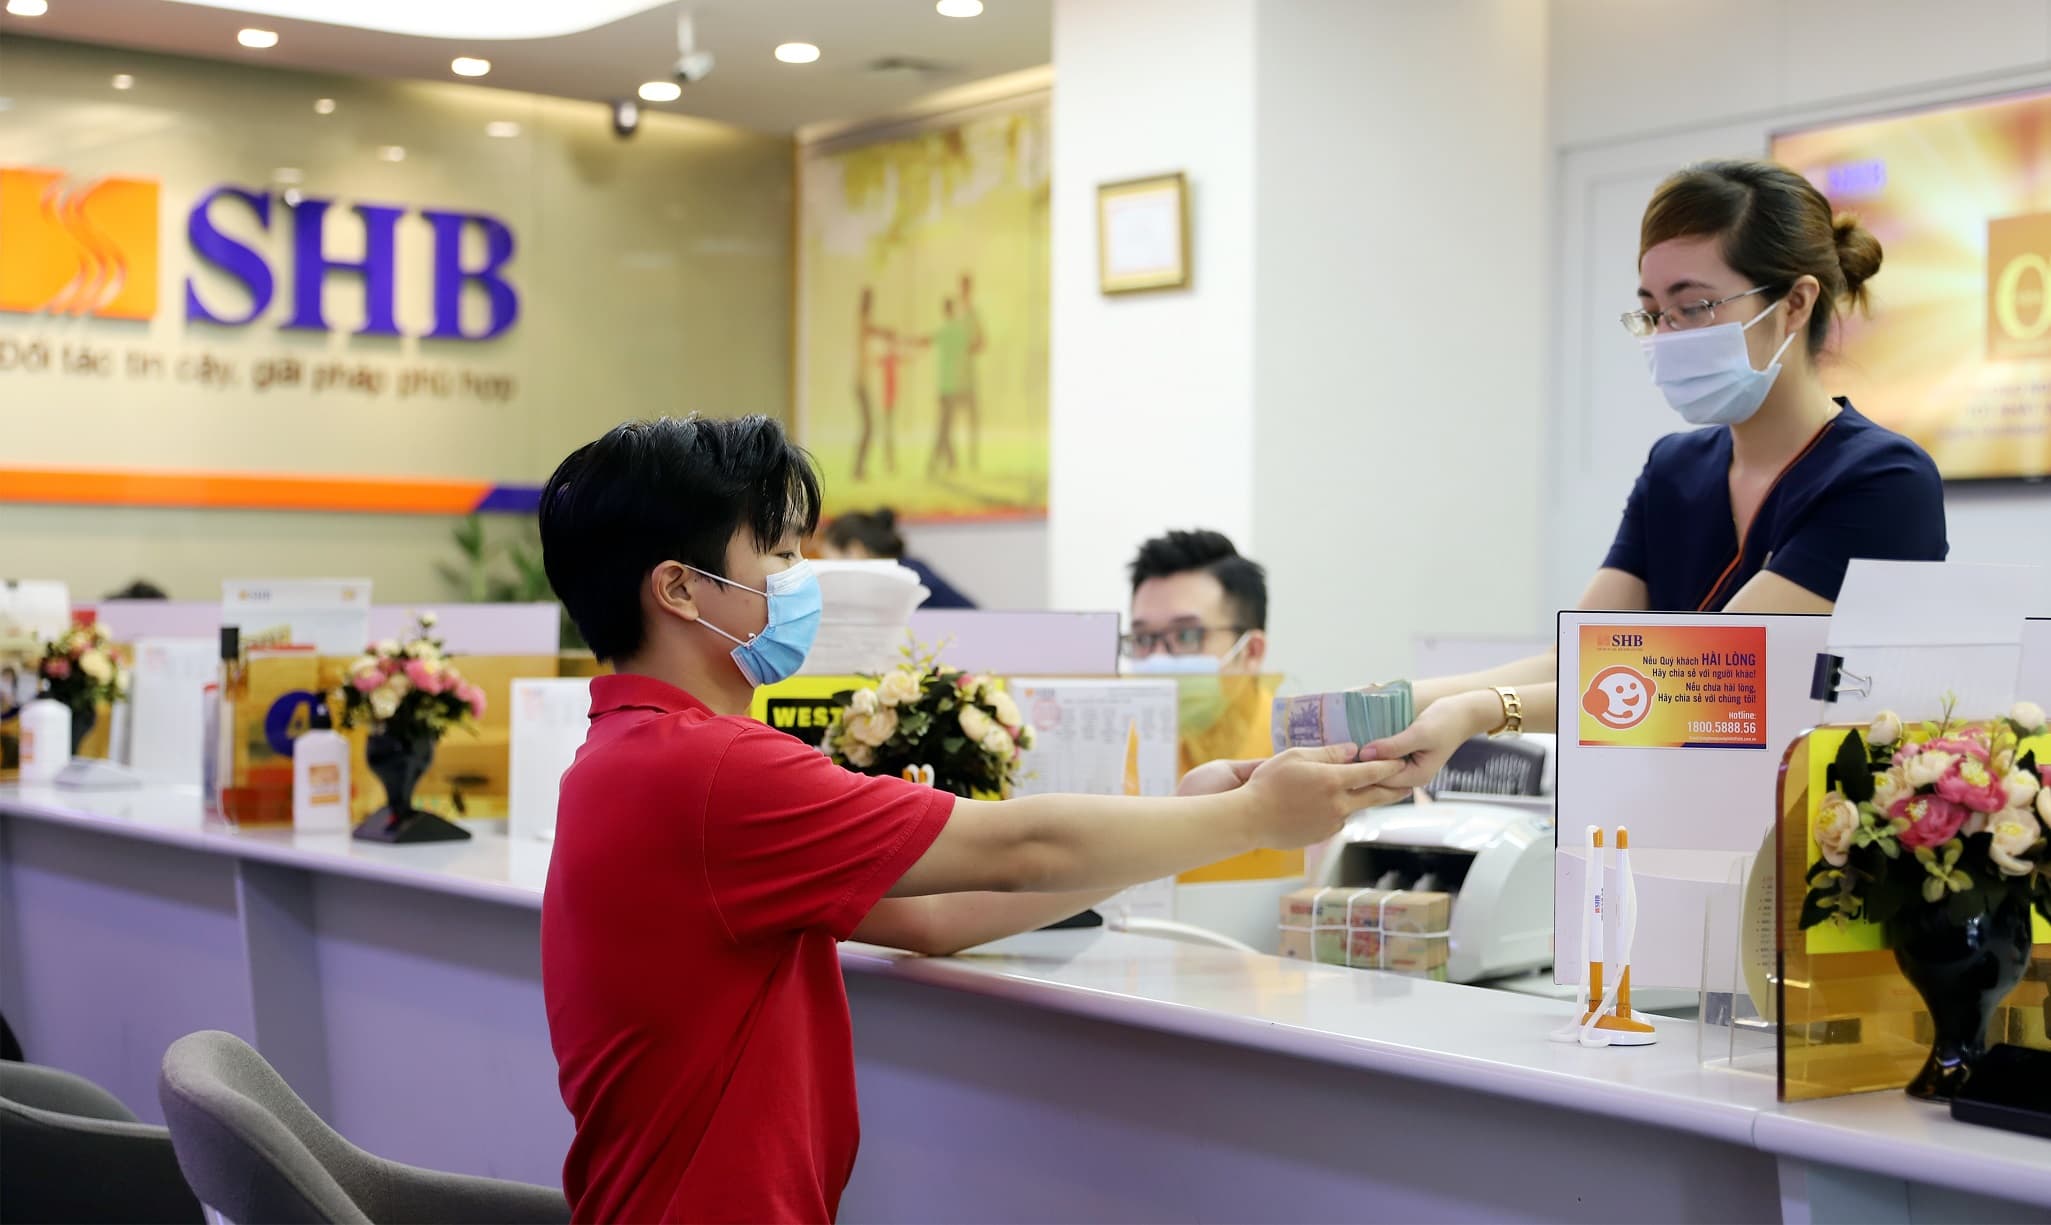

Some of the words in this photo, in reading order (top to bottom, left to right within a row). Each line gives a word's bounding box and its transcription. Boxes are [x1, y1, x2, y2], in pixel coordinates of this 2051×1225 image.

[185, 184, 520, 341] SHB
[1611, 634, 1643, 647] SHB
[1676, 656, 1699, 665] khách
[1702, 651, 1721, 666] HÀI
[1725, 651, 1756, 666] LÒNG
[1669, 668, 1685, 677] chia
[1686, 681, 1701, 692] Nếu
[1674, 693, 1690, 703] chia
[1687, 720, 1756, 734] 1800.5888.56
